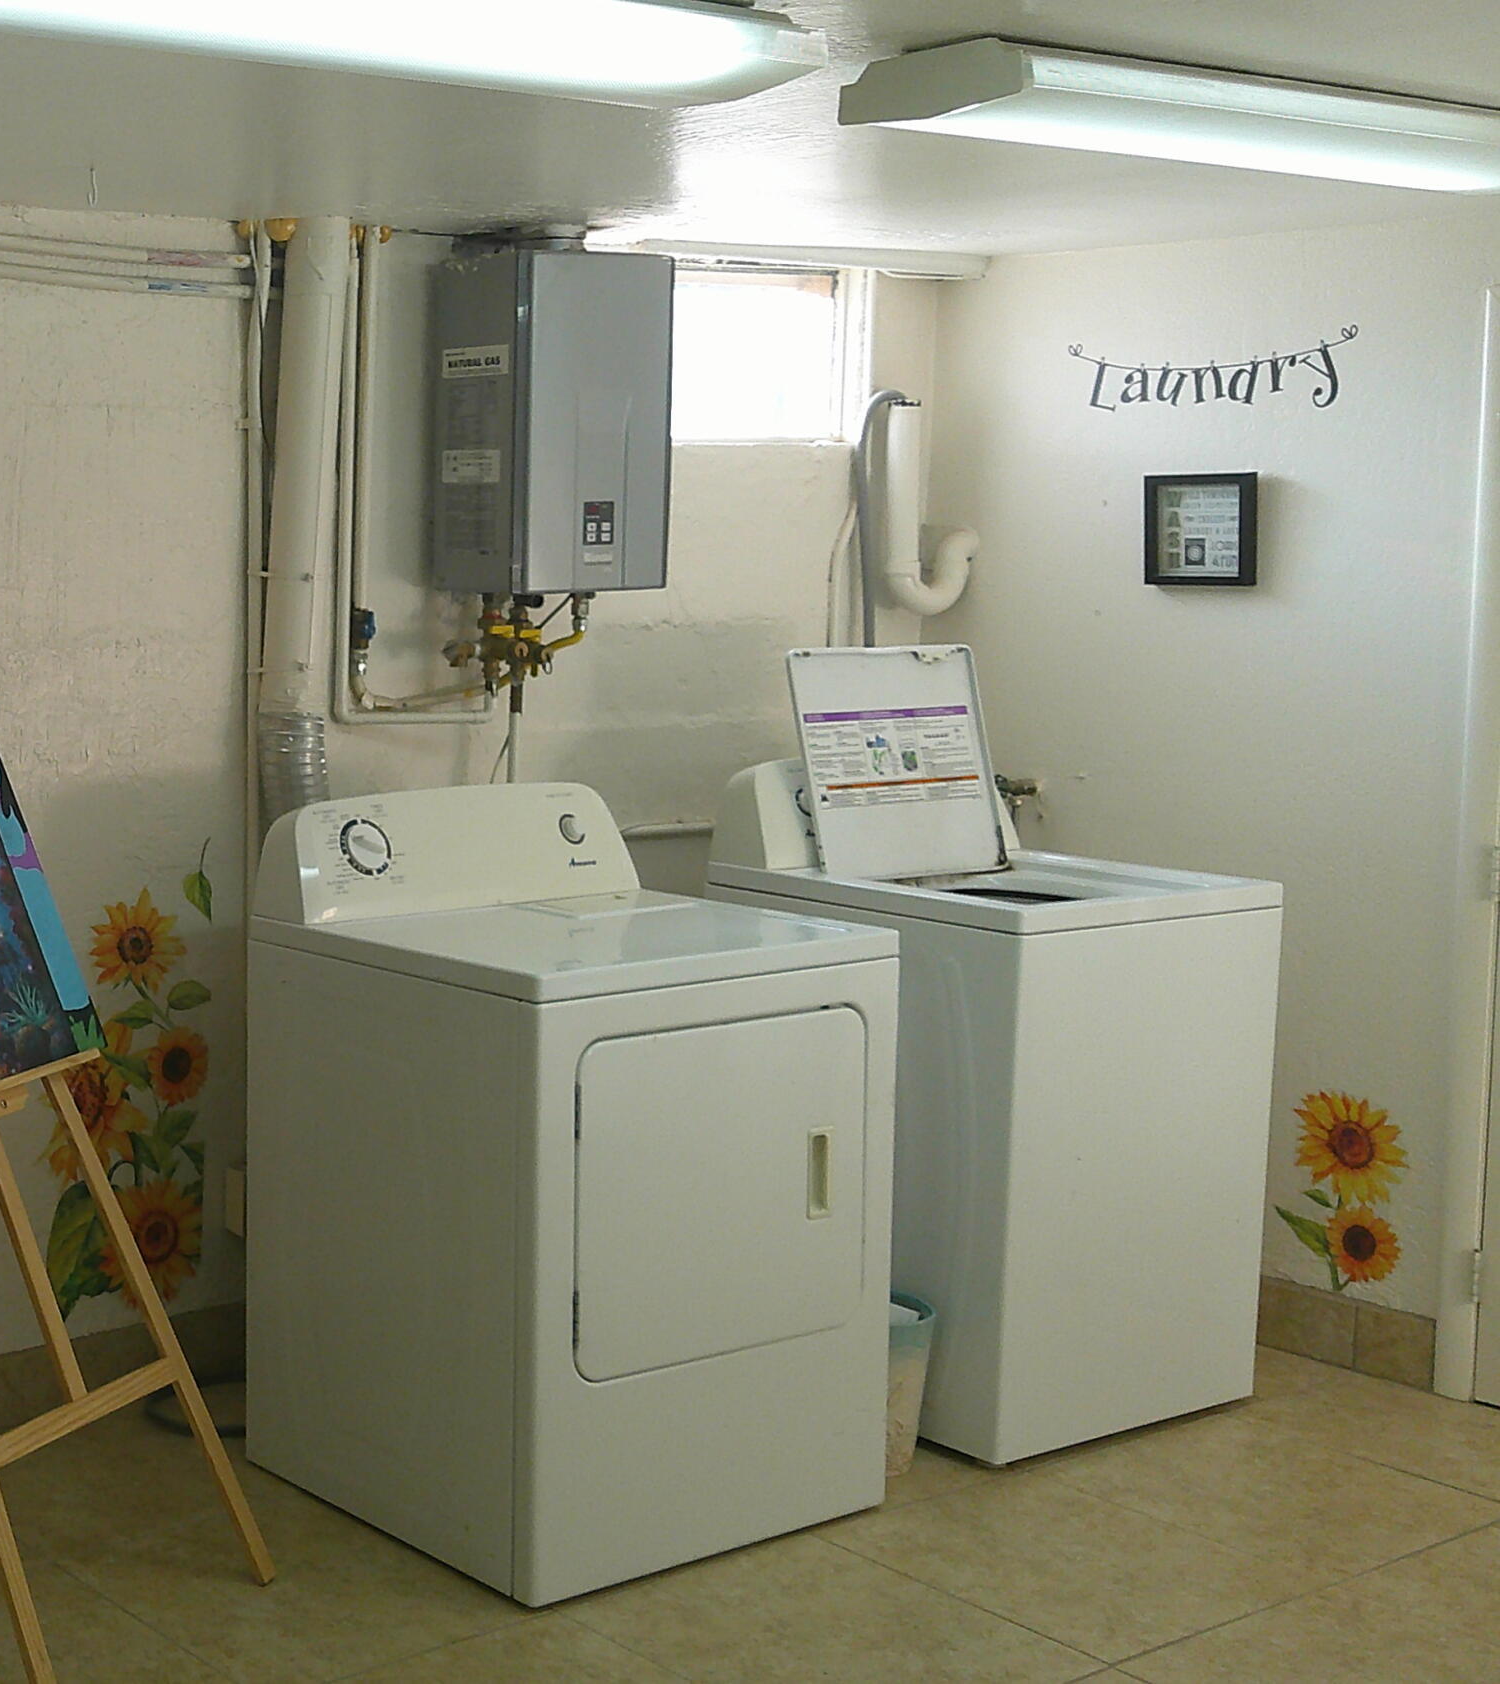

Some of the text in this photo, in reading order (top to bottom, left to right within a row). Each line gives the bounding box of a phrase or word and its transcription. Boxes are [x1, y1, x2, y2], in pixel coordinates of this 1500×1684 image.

[448, 355, 501, 368] NATURAL GAS
[1089, 346, 1339, 411] Laundry
